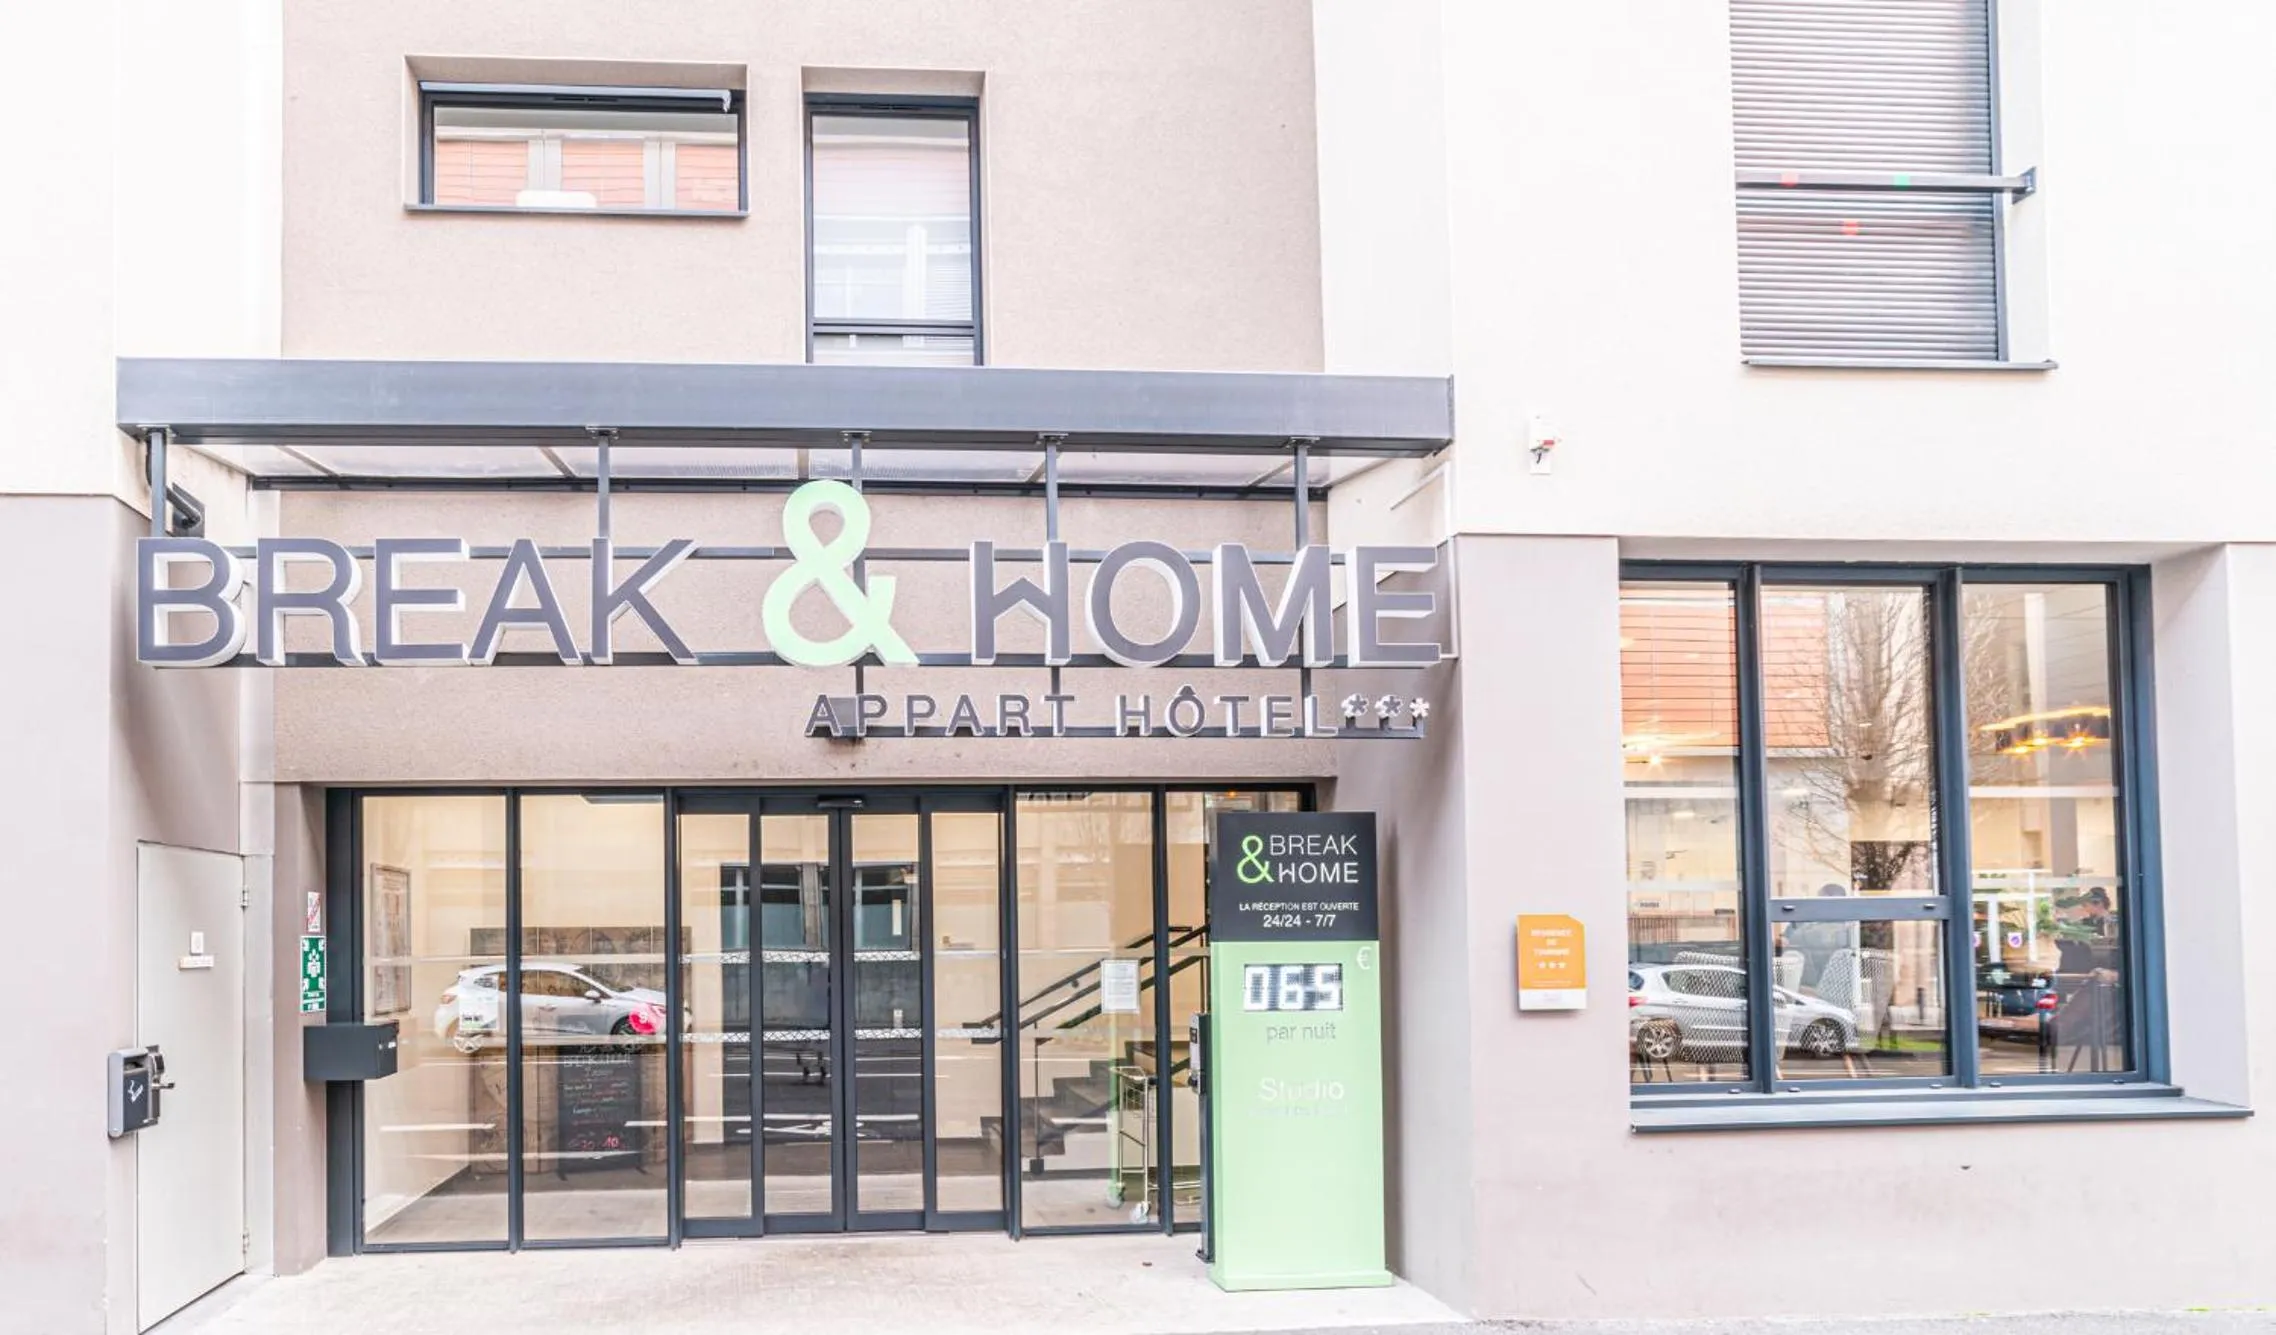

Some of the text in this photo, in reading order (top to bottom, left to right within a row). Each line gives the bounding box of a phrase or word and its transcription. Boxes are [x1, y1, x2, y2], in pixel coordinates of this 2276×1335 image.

[137, 479, 1442, 667] BREAK & HOME
[805, 684, 1339, 737] APPART HÔTEL
[1236, 834, 1358, 884] & BREAK
[1278, 862, 1359, 884] HOME
[1239, 902, 1251, 911] LA
[1301, 902, 1317, 911] EST
[1320, 902, 1360, 911] OUVERTE
[1263, 914, 1301, 928] 24/24
[1315, 914, 1336, 928] 7/7
[1356, 946, 1373, 970] €
[1266, 1022, 1337, 1043] par nuit
[1259, 1077, 1345, 1103] Studio
